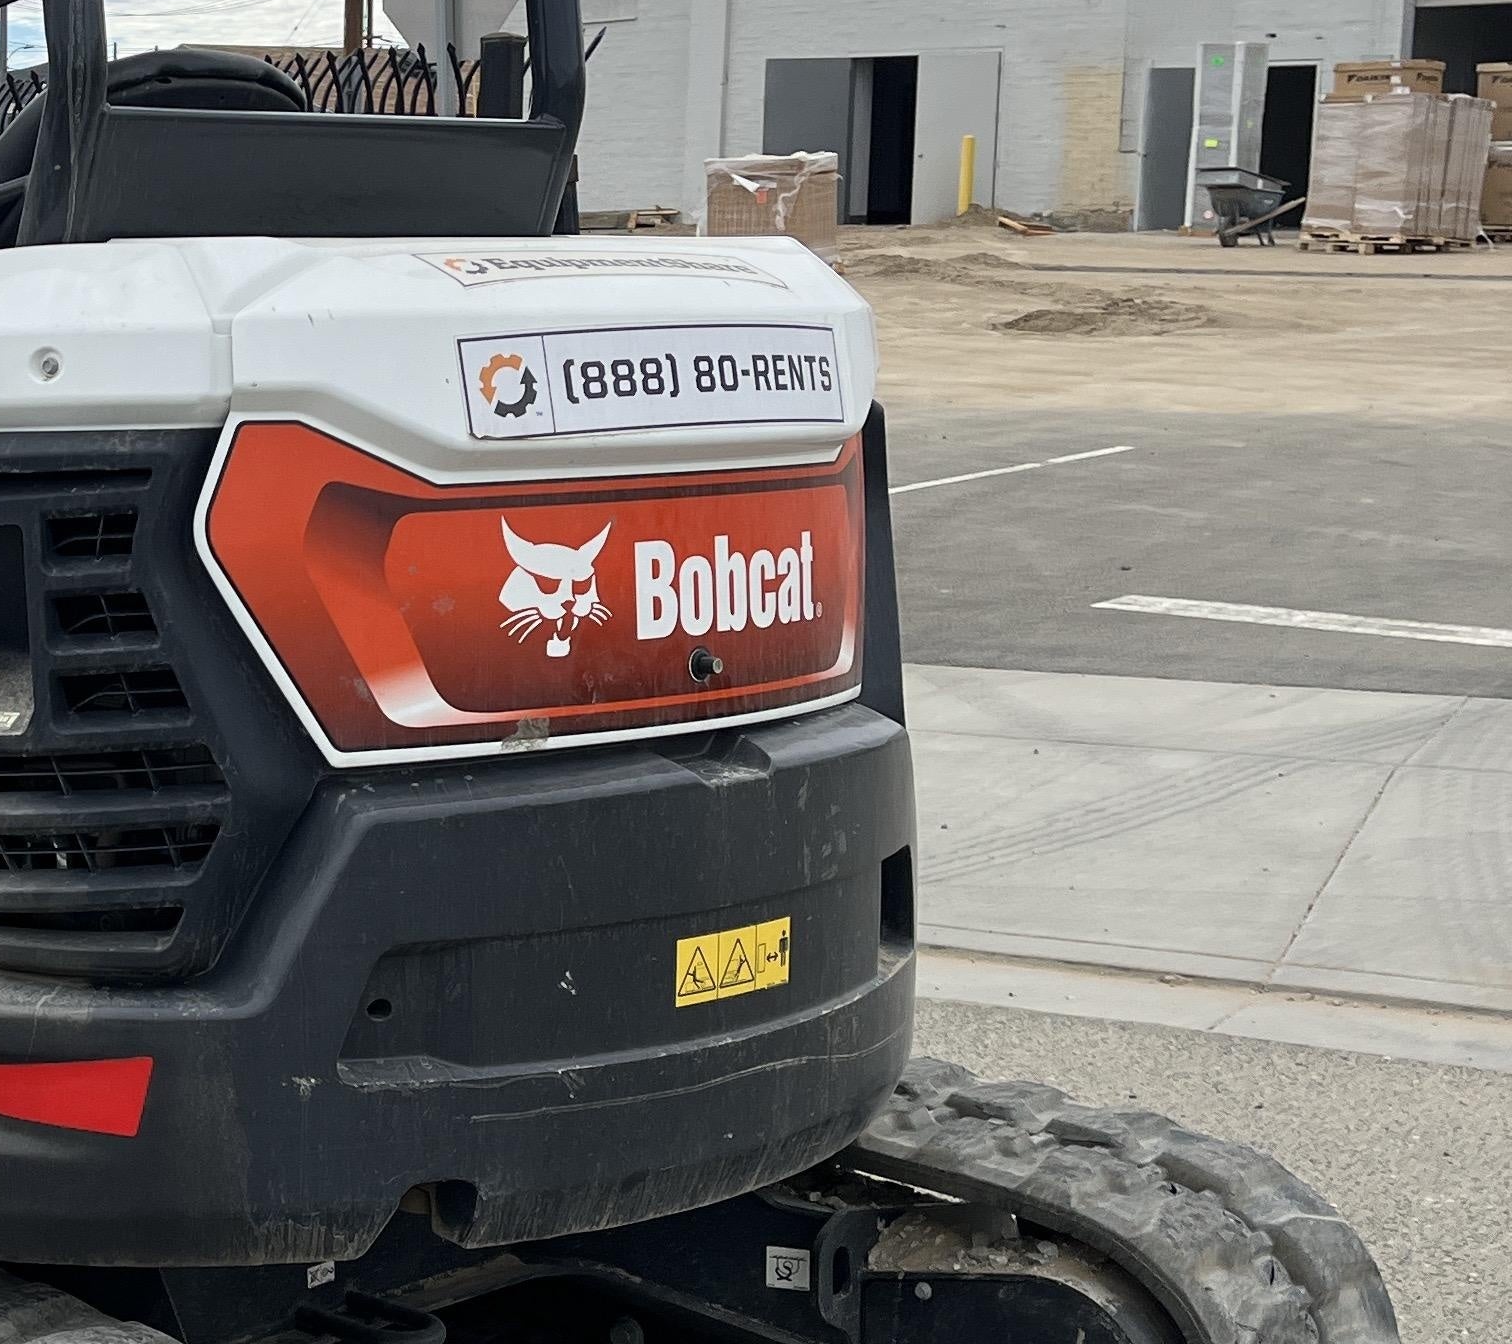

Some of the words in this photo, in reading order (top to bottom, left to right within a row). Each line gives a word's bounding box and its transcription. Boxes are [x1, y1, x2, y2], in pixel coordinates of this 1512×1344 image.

[485, 256, 759, 276] EquipmentShare
[562, 353, 680, 404] (888)
[693, 354, 833, 393] 80-RENTS
[633, 530, 815, 641] Bobcat
